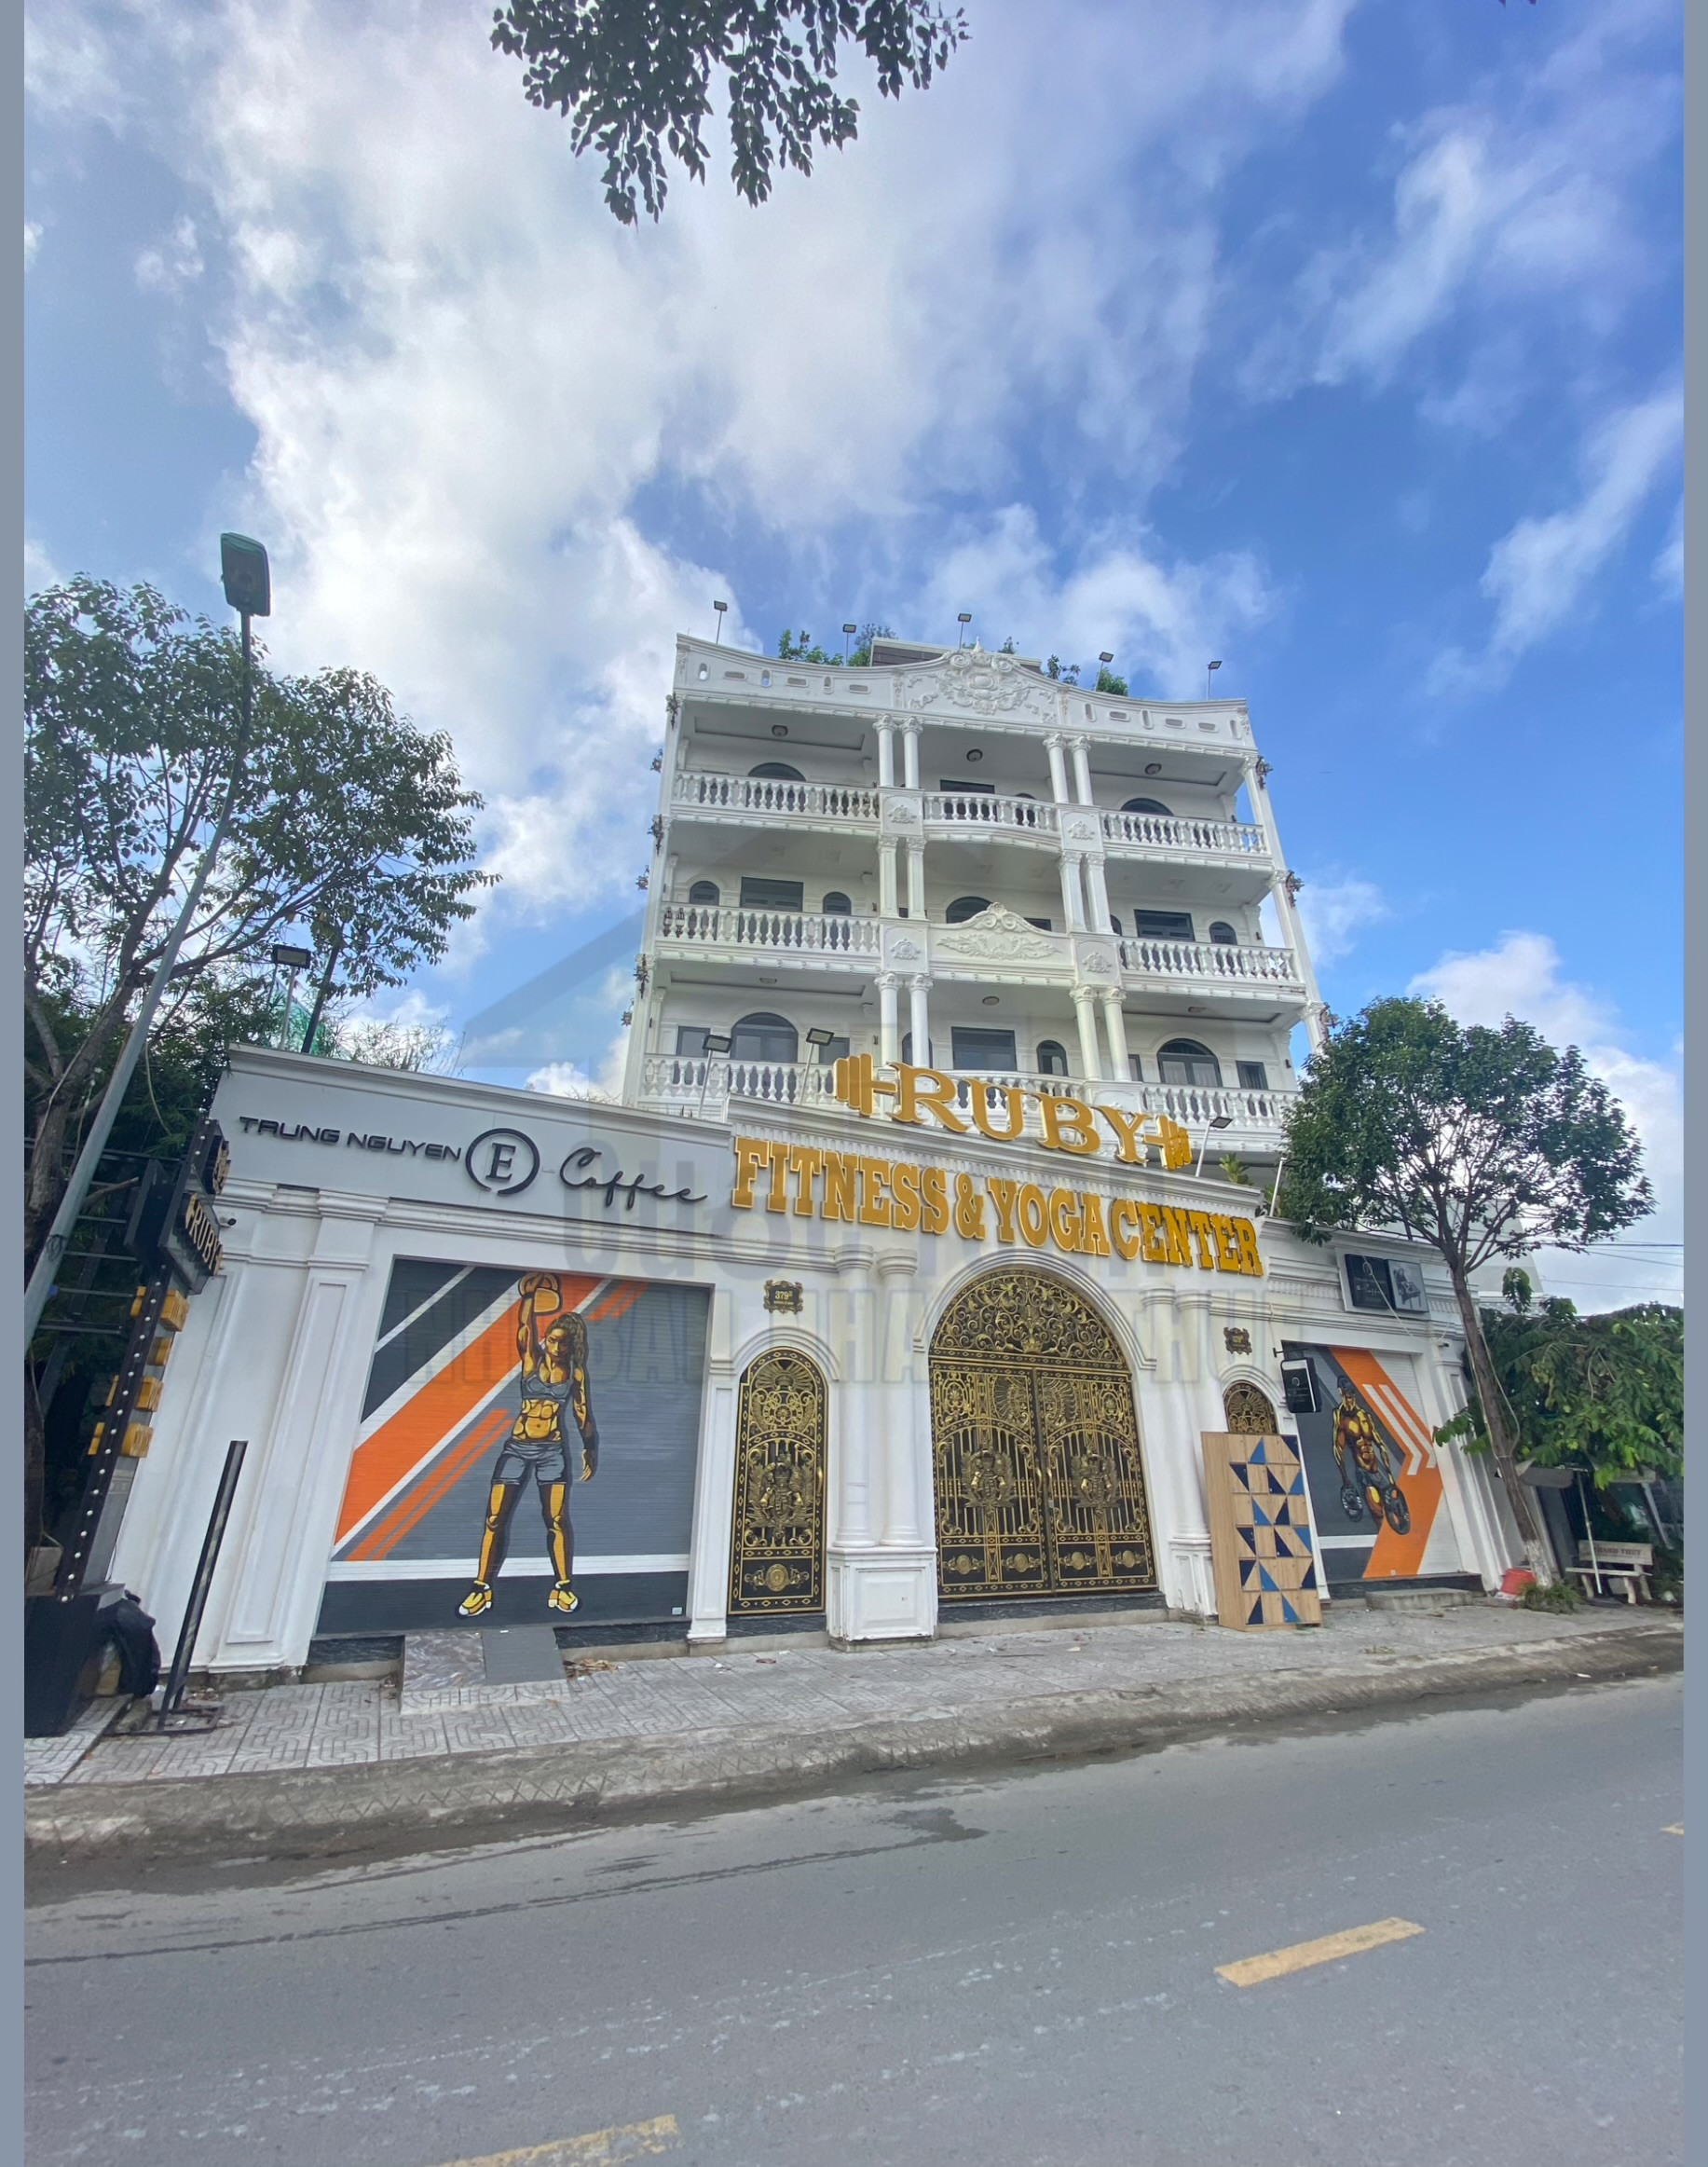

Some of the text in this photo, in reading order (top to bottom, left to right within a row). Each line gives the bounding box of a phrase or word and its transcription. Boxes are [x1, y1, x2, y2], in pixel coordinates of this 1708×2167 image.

[885, 1062, 1154, 1165] RUBY
[239, 1116, 341, 1144] TRUNG
[347, 1132, 462, 1161] NGUYEN
[559, 1146, 708, 1211] Coffee
[731, 1135, 950, 1236] FITNESS
[955, 1171, 987, 1241] &
[987, 1175, 1112, 1257] YOGA
[1110, 1197, 1265, 1277] CENTER
[189, 1200, 220, 1271] RUBY
